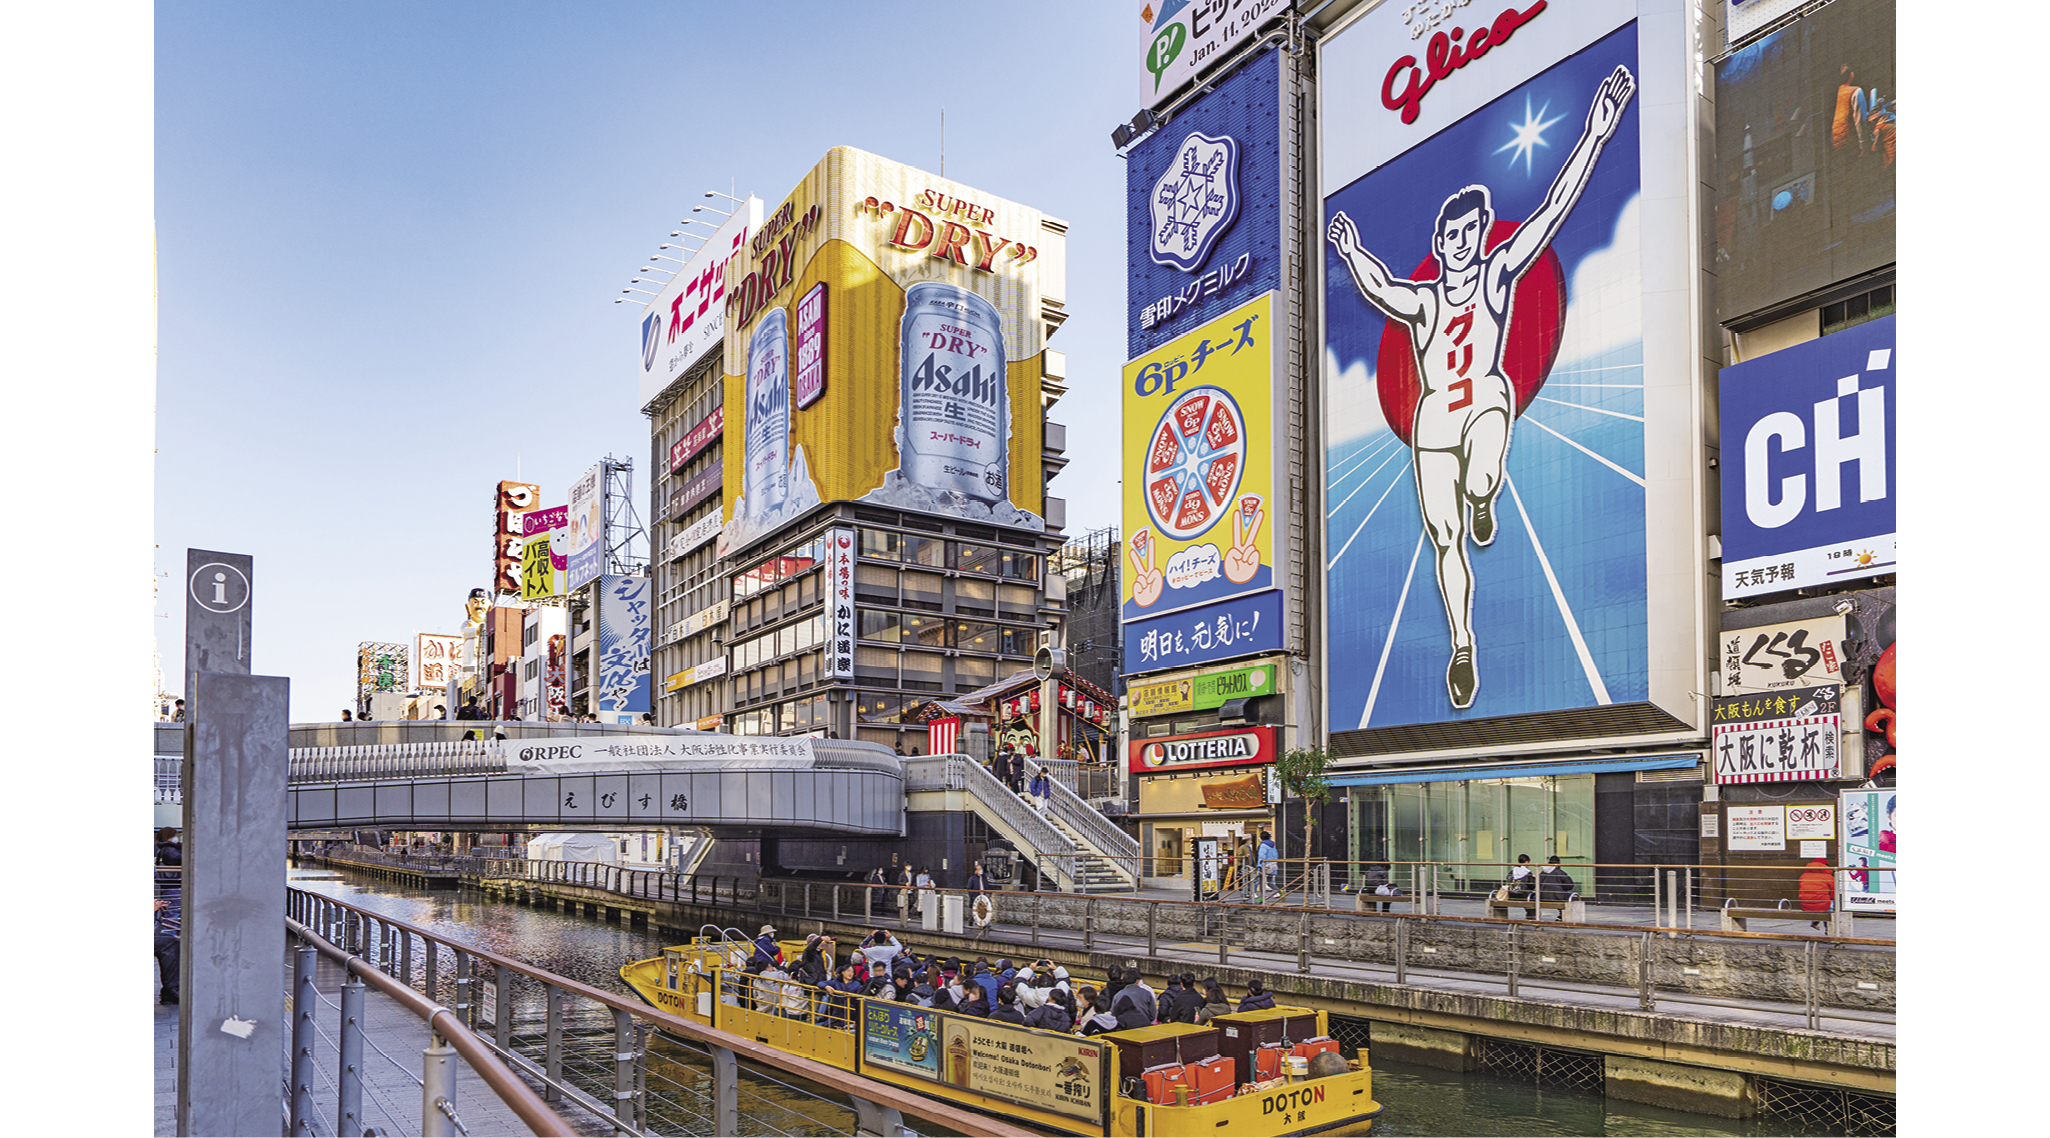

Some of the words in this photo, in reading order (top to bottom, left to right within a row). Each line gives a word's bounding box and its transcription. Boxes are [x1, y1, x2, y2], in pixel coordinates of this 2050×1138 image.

[1189, 42, 1220, 67] Jan.
[1381, 0, 1548, 125] Glico
[921, 188, 995, 226] SUPER
[752, 201, 792, 260] SUPER
[1139, 252, 1250, 331] 雪印メグミルク
[798, 291, 821, 337] ASAHI
[940, 323, 971, 339] SUPER
[1191, 314, 1259, 375] チーズ
[798, 331, 821, 373] 1889
[1443, 303, 1476, 413] グリコ
[798, 363, 820, 402] OSAKA
[912, 352, 996, 408] Asahi
[750, 372, 785, 435] Asahi
[944, 401, 966, 421] 生
[1180, 398, 1205, 417] SNOW
[930, 431, 981, 449] スーパードライ
[524, 542, 537, 597] バイト
[537, 540, 550, 593] 高収入
[838, 552, 851, 600] 本場の味
[1169, 552, 1217, 574] ハイ!チーズ
[1735, 563, 1796, 589] 天気予報
[614, 579, 650, 673] シャッターは
[836, 604, 851, 673] かに道楽
[1140, 610, 1260, 663] 明日を、元気に!
[1742, 629, 1820, 680] くくる
[1714, 695, 1801, 721] 大阪もんを食す
[1812, 686, 1836, 700] くくる
[1820, 701, 1837, 713] 2F
[519, 745, 582, 761] ORPEC
[594, 744, 676, 757] 一般社団法人
[680, 743, 806, 756] 大阪活性化事業実行委員会
[1168, 737, 1247, 761] LOTTERIA
[1719, 727, 1820, 774] 大阪に乾杯
[563, 791, 688, 812] えびす橋
[657, 991, 685, 1009] DOTON
[972, 1049, 999, 1061] Welcome!
[1001, 1055, 1019, 1066] Osaka
[1021, 1059, 1052, 1072] Dotonbori
[1078, 1047, 1098, 1057] KIRIN
[1055, 1081, 1090, 1098] 一番搾り
[1055, 1094, 1069, 1102] KIRIN
[1070, 1097, 1091, 1108] ICHIBAN
[1262, 1085, 1325, 1116] DOTON
[1282, 1110, 1306, 1125] 大阪
